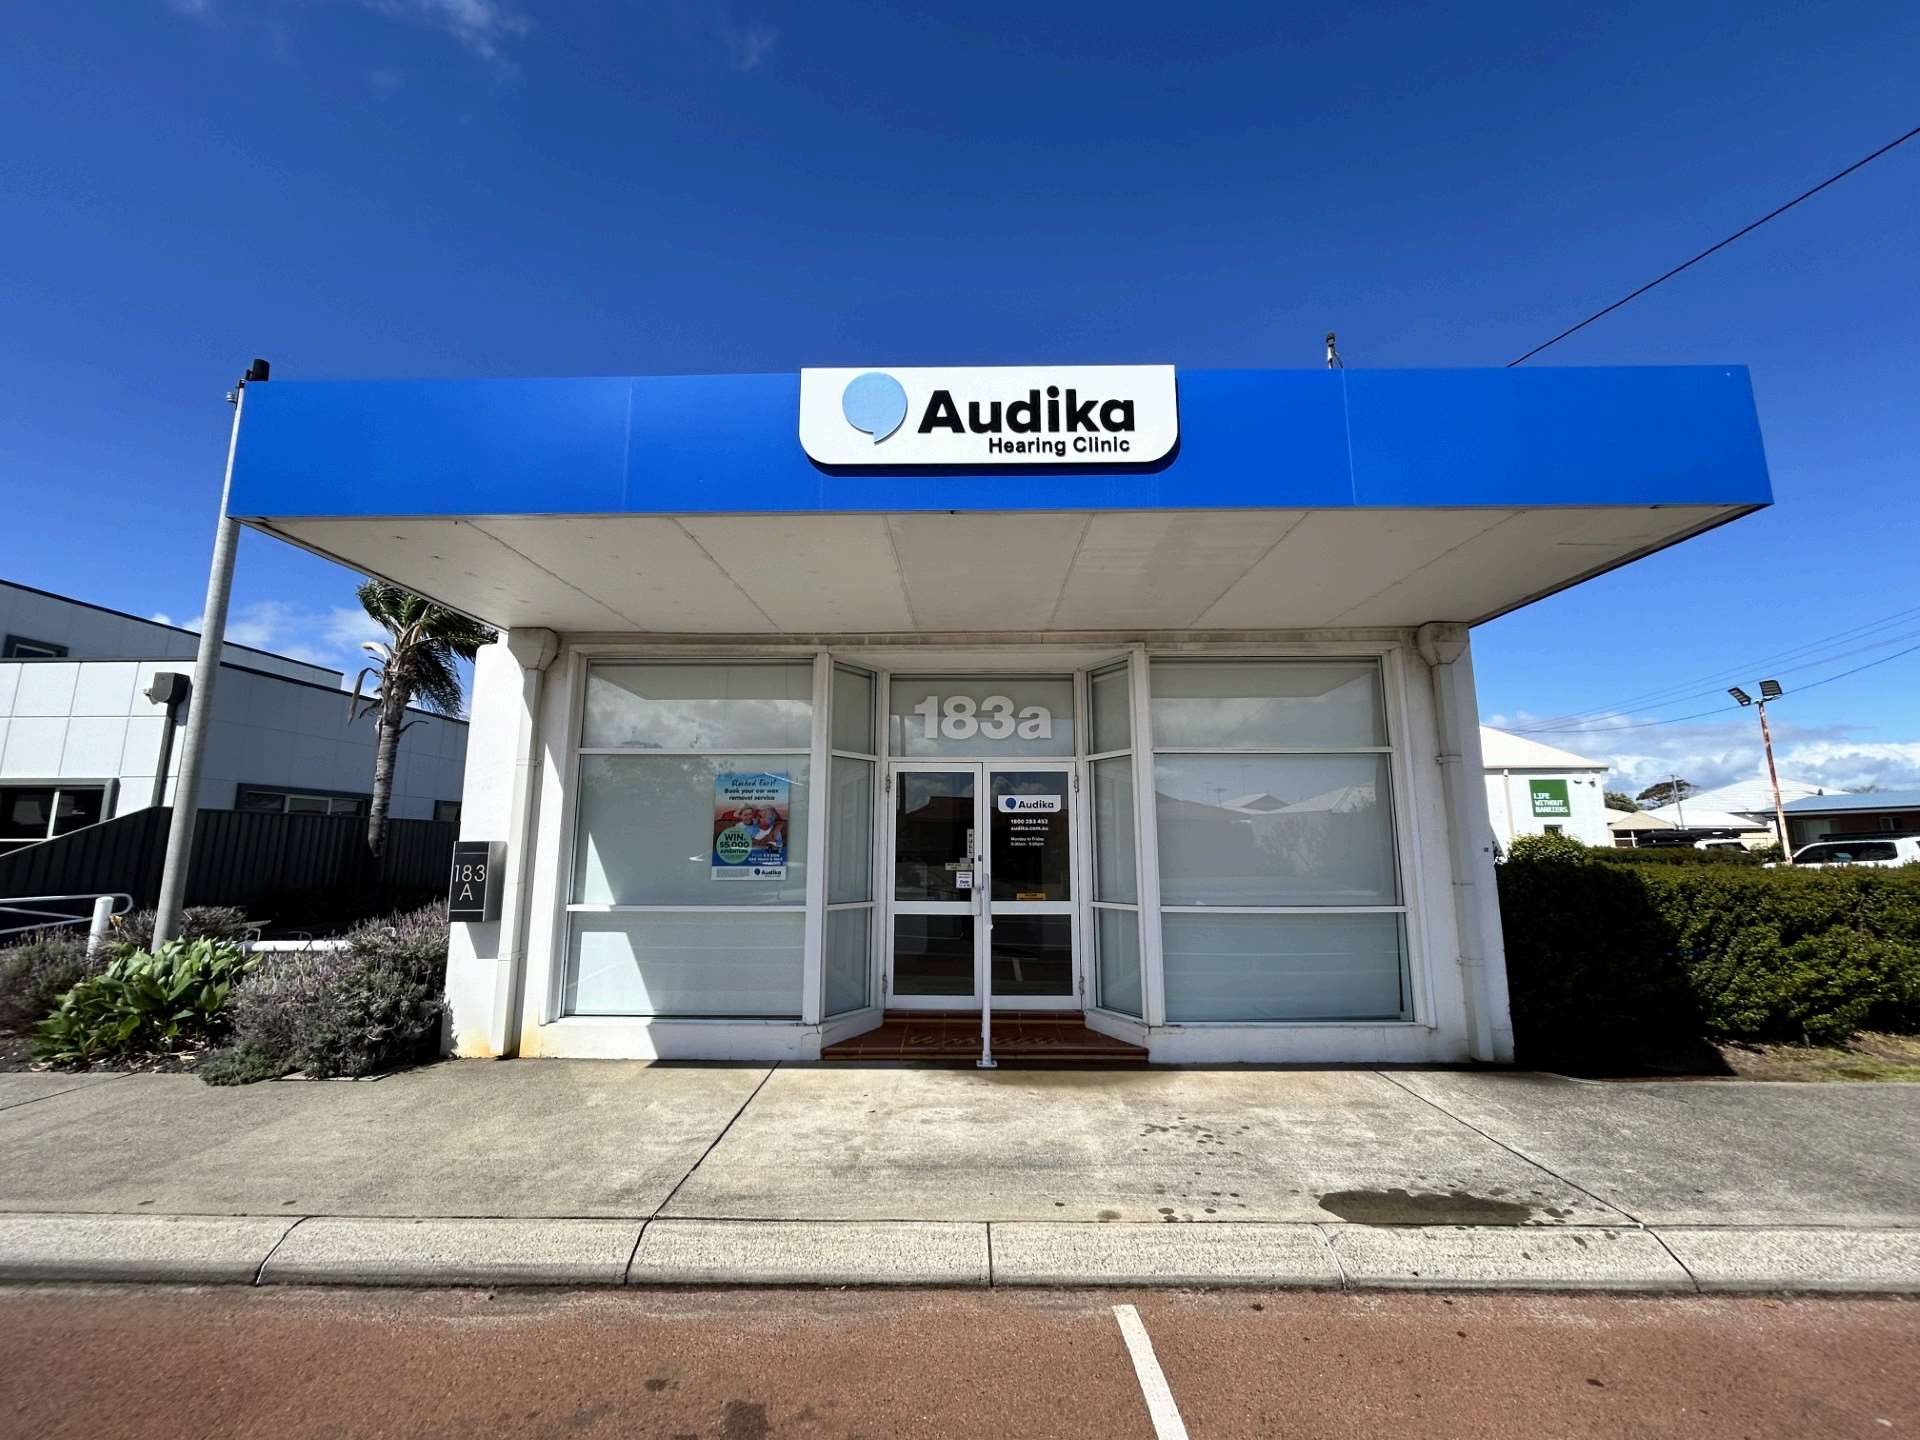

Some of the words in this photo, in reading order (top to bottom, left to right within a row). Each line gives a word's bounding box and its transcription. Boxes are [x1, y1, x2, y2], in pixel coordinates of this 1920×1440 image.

[917, 385, 1135, 434] Audika
[988, 436, 1066, 456] Hearing
[1072, 436, 1131, 454] Clinic
[914, 695, 1052, 740] 183a
[1018, 799, 1054, 809] Audika
[455, 864, 486, 882] 183
[459, 883, 473, 901] A
